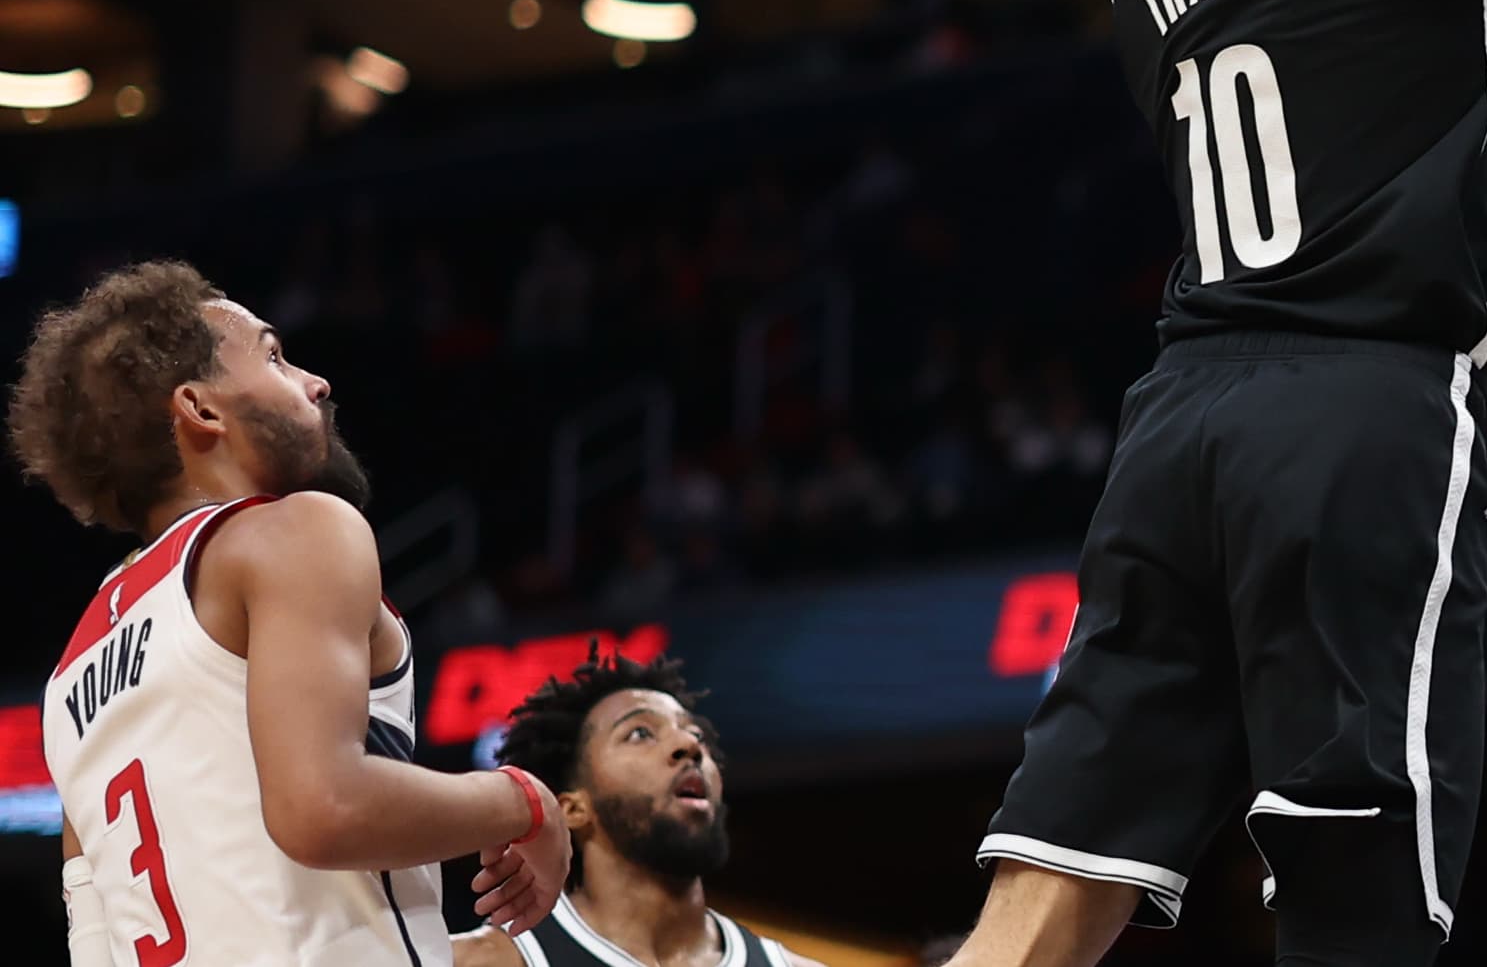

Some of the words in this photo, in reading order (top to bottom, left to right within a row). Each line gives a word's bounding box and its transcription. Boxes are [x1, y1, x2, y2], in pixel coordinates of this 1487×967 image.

[1171, 43, 1302, 284] 10
[65, 618, 153, 740] YOUNG
[105, 758, 187, 967] 3
